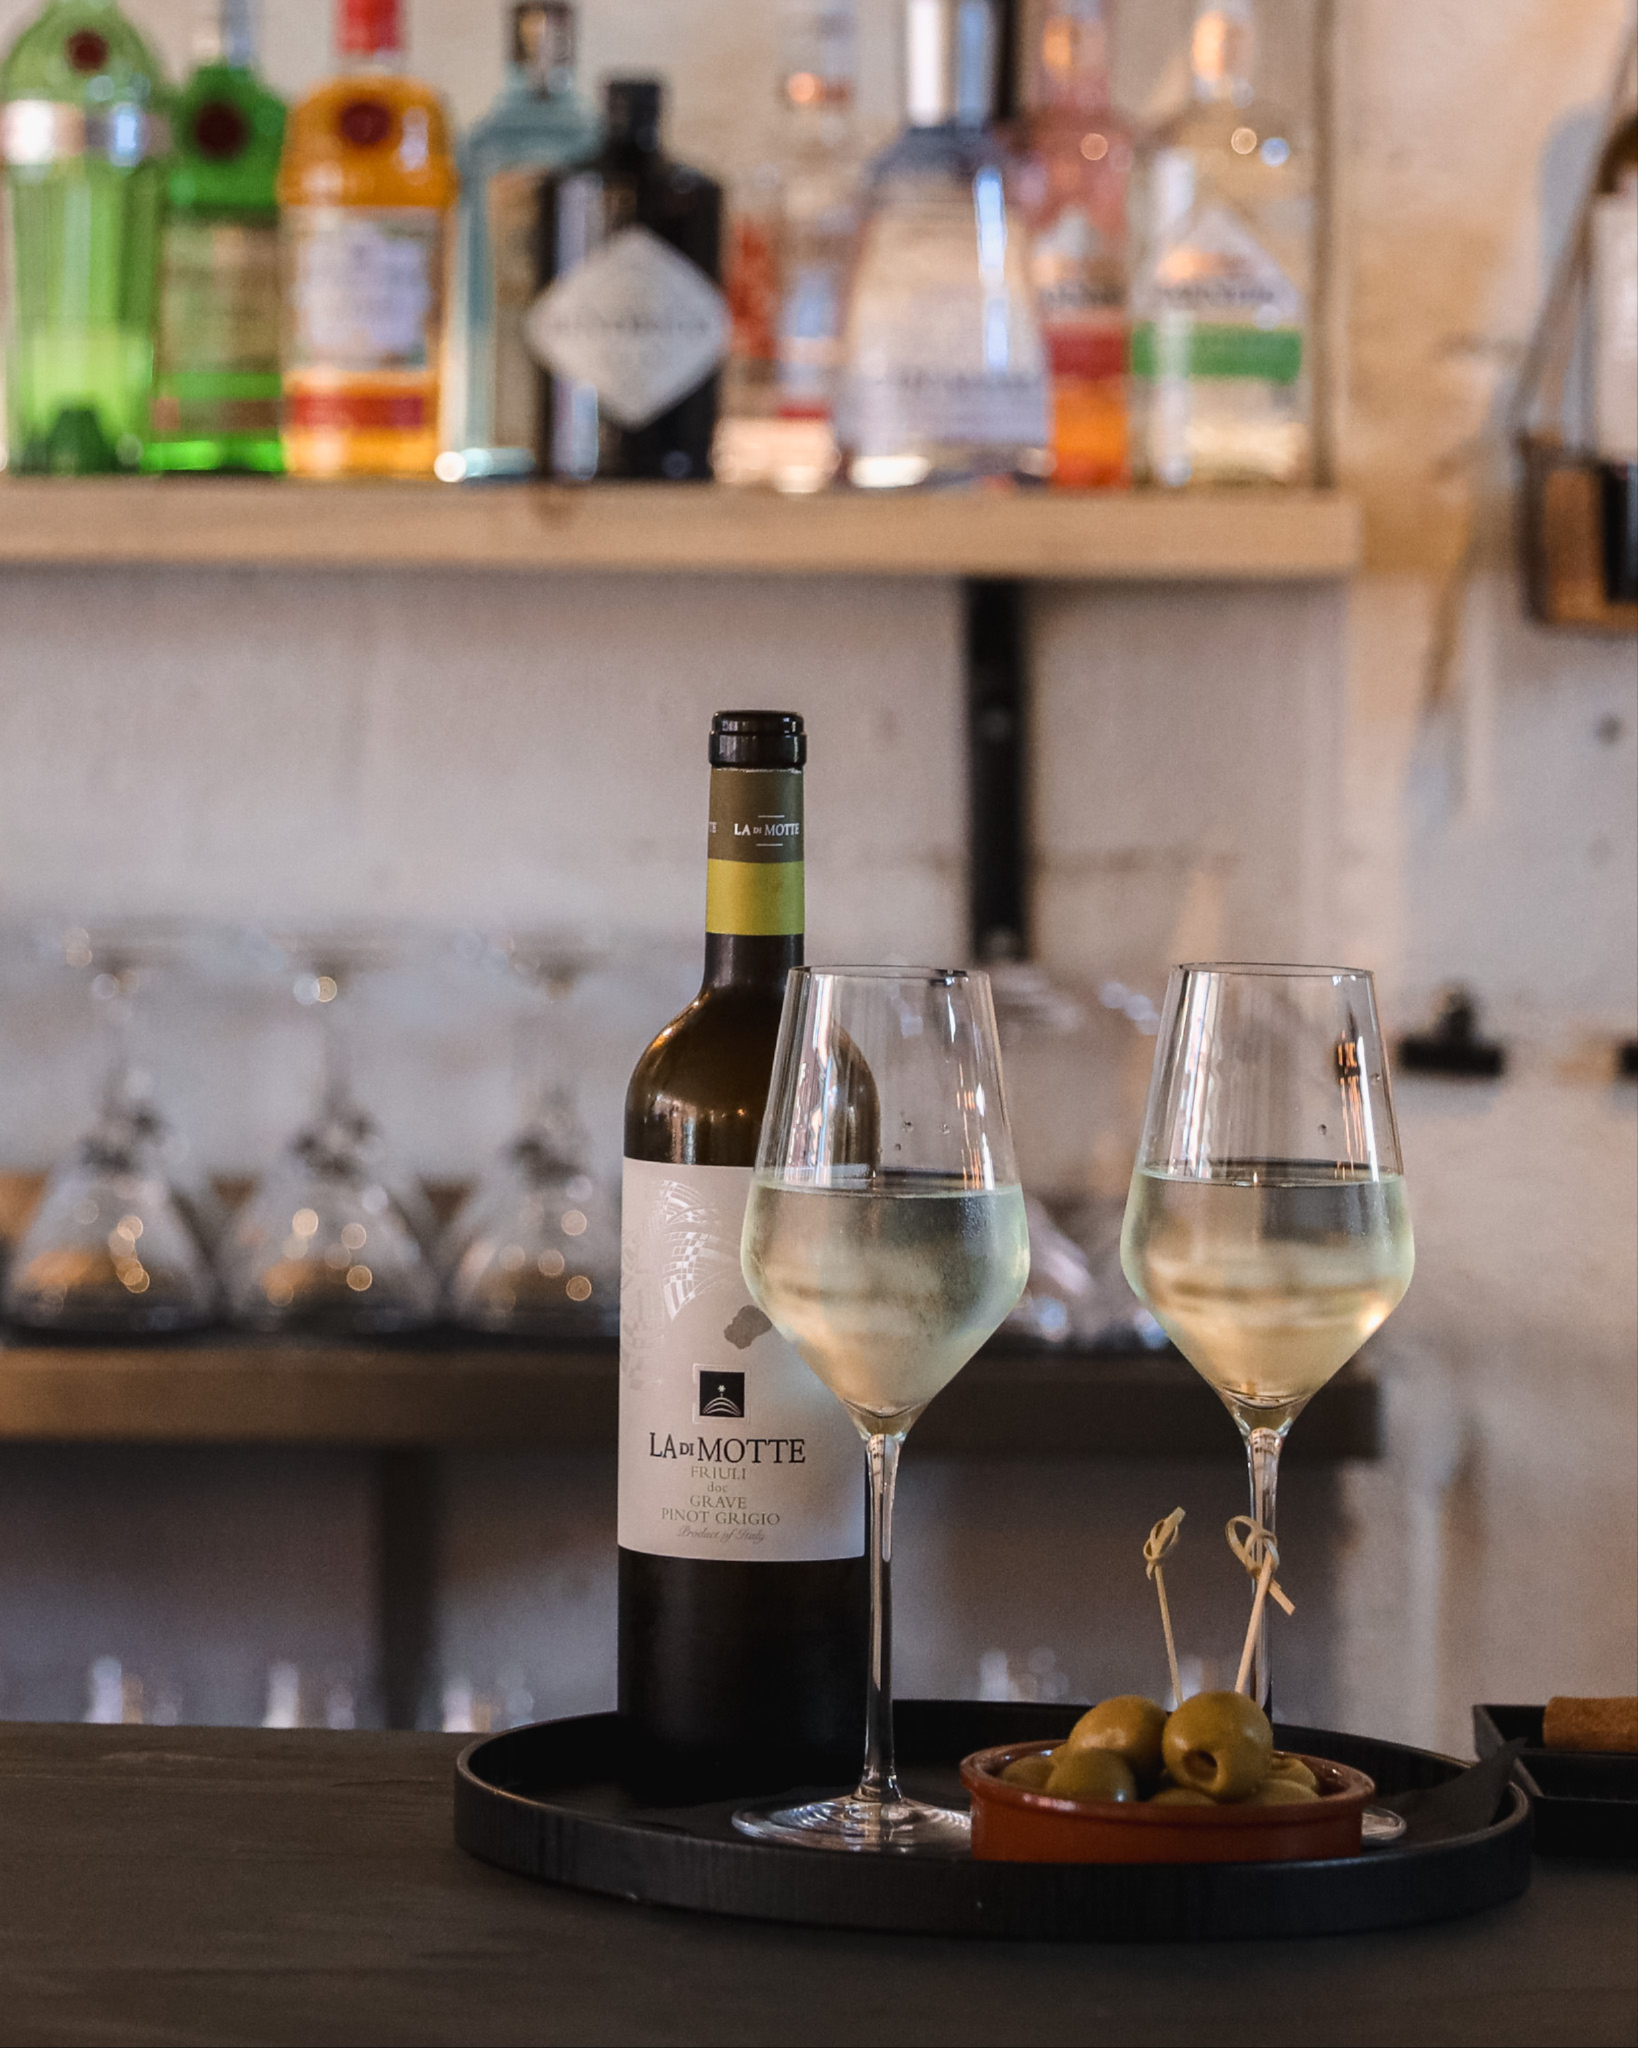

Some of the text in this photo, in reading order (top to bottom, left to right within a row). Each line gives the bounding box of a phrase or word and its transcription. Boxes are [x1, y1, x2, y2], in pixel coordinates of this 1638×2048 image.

[734, 823, 751, 835] LA
[764, 823, 799, 836] MOTTE
[650, 1432, 805, 1463] LA DI MOTTE
[691, 1466, 746, 1479] FRIULI
[707, 1481, 728, 1493] doc
[690, 1495, 747, 1509] GRAVE
[662, 1508, 780, 1525] PINOT GRIGIO
